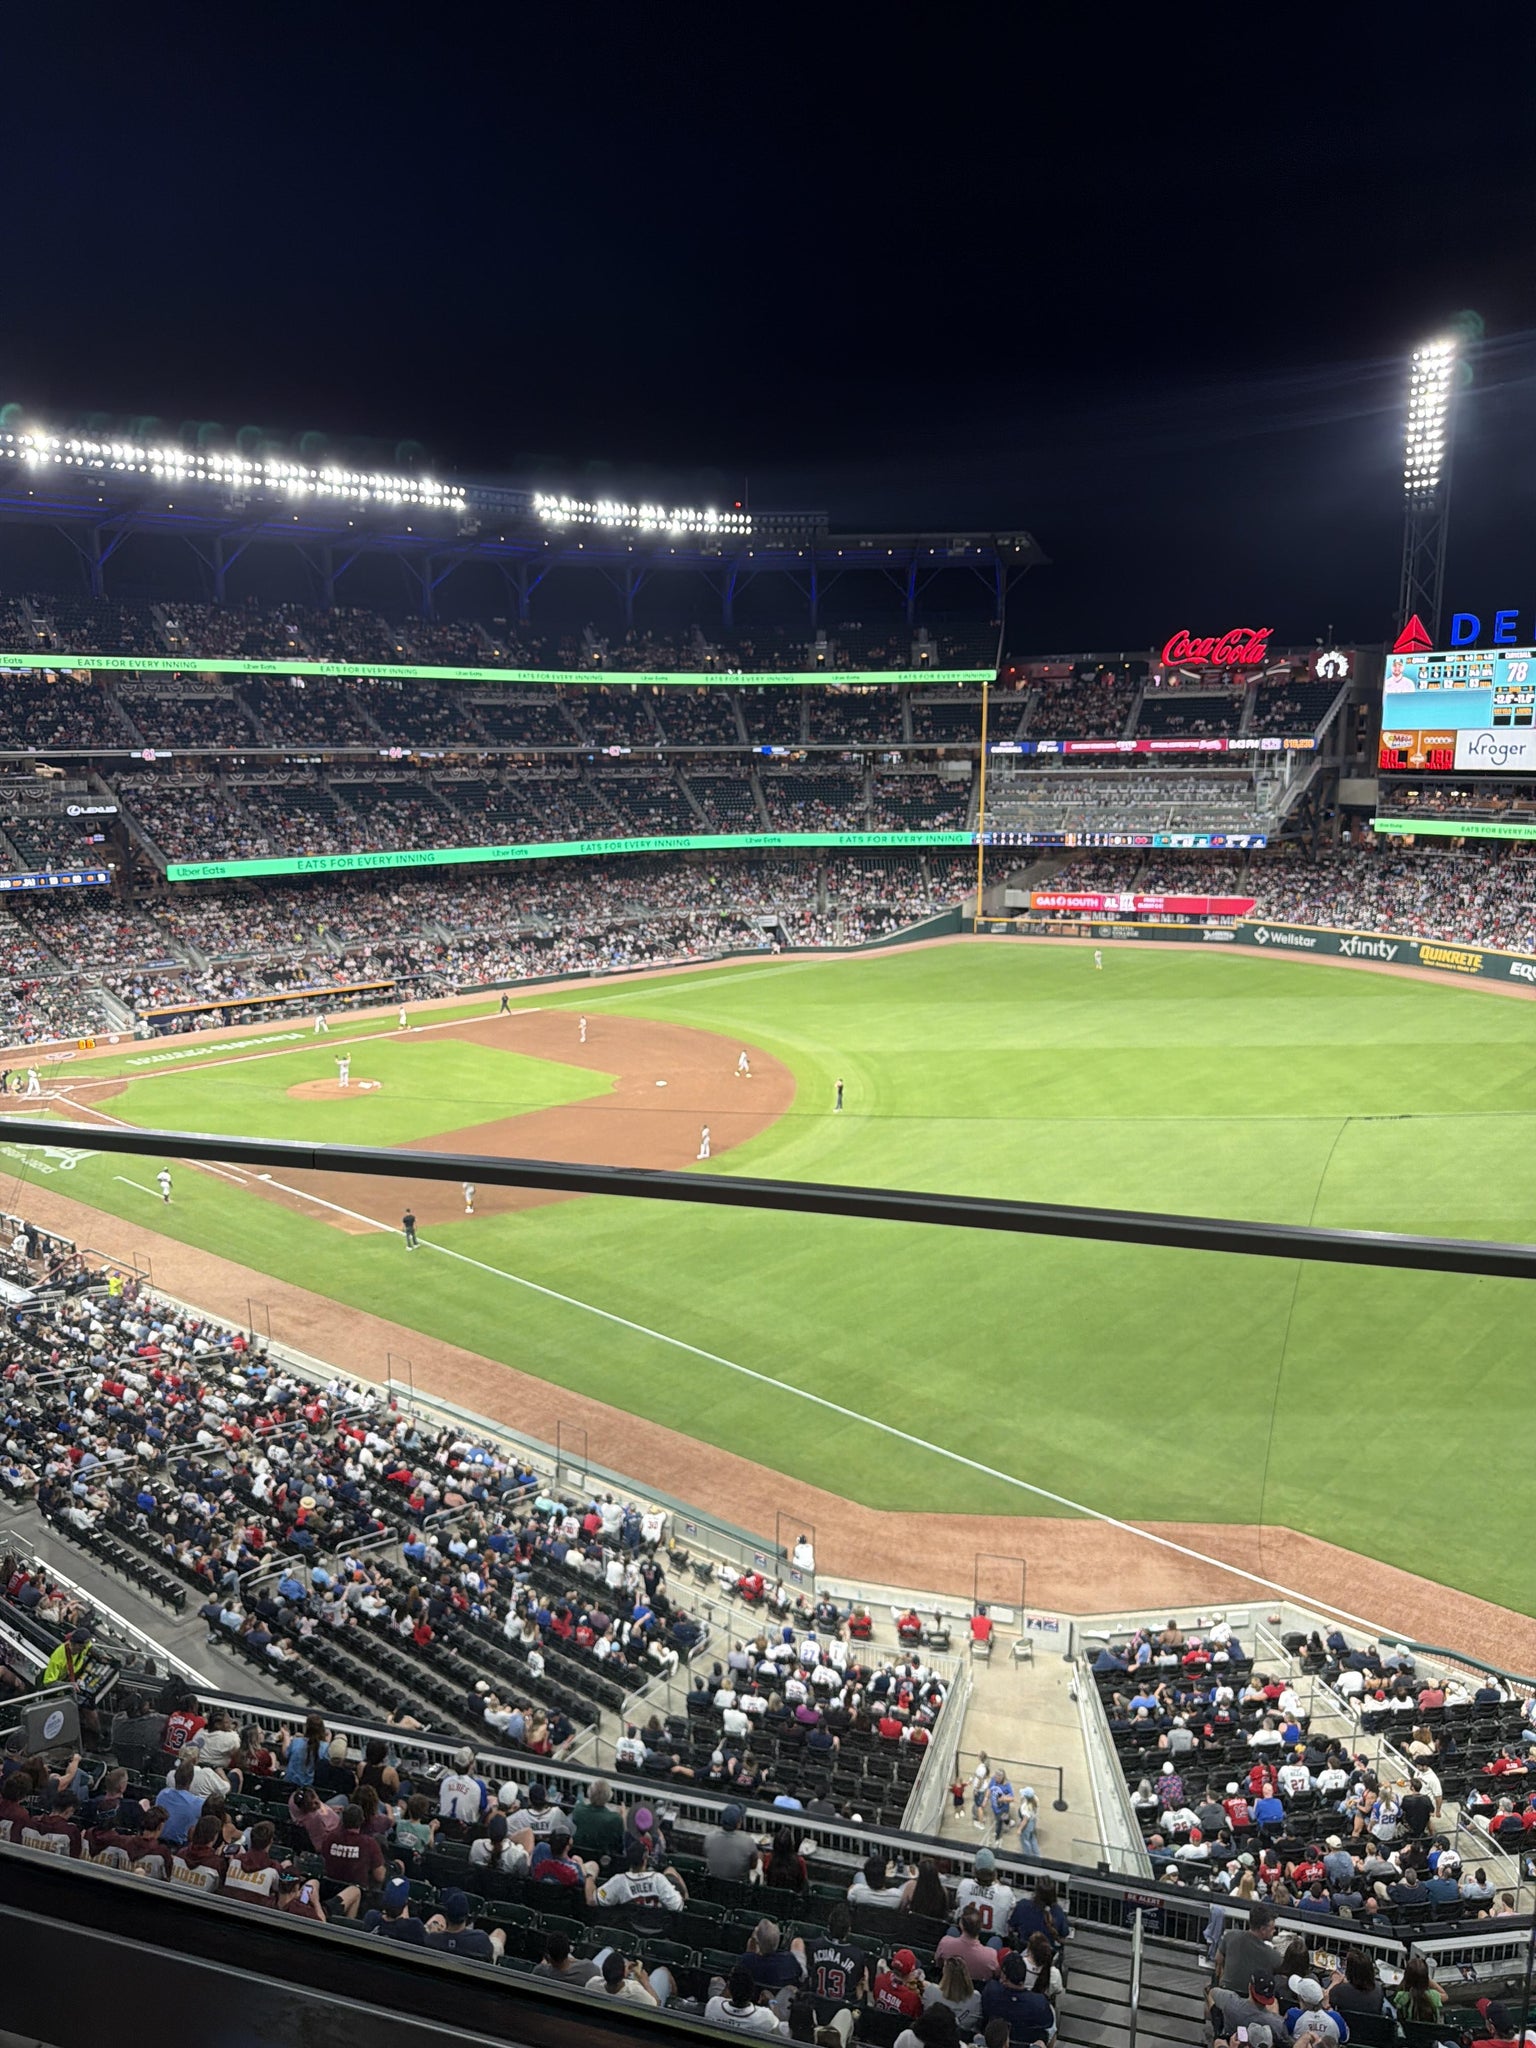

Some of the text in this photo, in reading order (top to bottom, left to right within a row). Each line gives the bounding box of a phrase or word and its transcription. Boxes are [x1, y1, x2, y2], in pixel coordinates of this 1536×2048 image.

[1451, 610, 1536, 645] DE
[1162, 628, 1273, 667] Coca-Cola
[134, 661, 159, 669] EVERY
[163, 661, 198, 669] INNING
[1507, 662, 1528, 683] 78
[1469, 733, 1526, 766] Kroger
[581, 844, 602, 852] EATS
[625, 840, 651, 848] EVERY
[655, 839, 691, 847] INNING
[298, 854, 435, 869] EATS FOR EVERY INNING
[177, 866, 226, 876] Uber Eats
[1036, 896, 1099, 907] GAS SOUTH
[1270, 932, 1316, 947] Wellstar
[1338, 936, 1399, 961] xfinity
[1419, 945, 1483, 969] QUIKRETE
[166, 1727, 187, 1750] 13
[1290, 1778, 1305, 1791] 27
[450, 1797, 458, 1818] 1
[1381, 1814, 1395, 1824] 28
[630, 1882, 653, 1896] RILEY
[970, 1886, 995, 1900] JONES
[813, 1948, 841, 1964] ACUÑA
[817, 1966, 846, 1999] 13
[1308, 2023, 1328, 2033] RILEY
